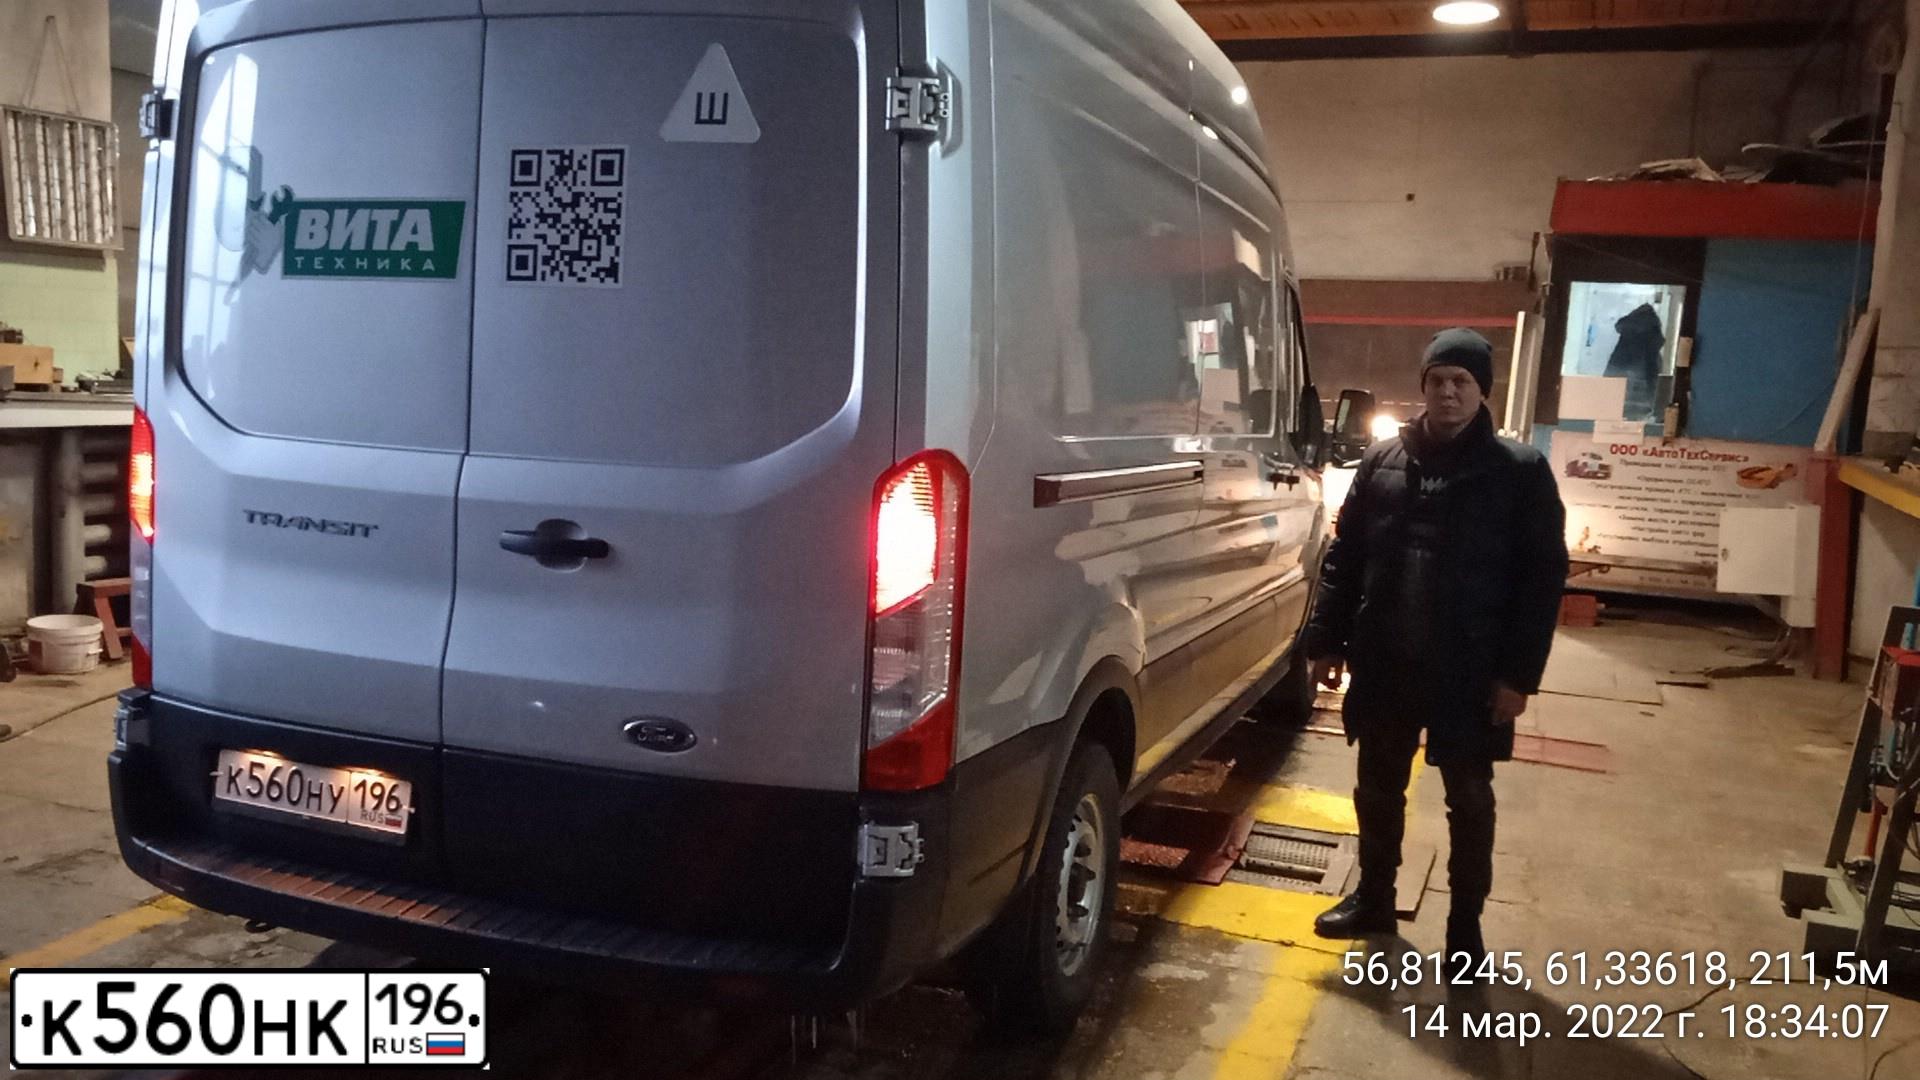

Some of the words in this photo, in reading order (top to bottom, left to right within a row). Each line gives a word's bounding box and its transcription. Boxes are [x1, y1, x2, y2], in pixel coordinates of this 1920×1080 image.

[694, 91, 729, 125] Ш
[294, 208, 434, 251] ВИТА
[294, 256, 435, 272] ТЕХНИКА
[1610, 443, 1638, 456] ООО
[243, 509, 379, 538] TRANSIT
[226, 761, 345, 813] К560НУ
[353, 778, 402, 813] 196
[360, 810, 386, 826] RUS
